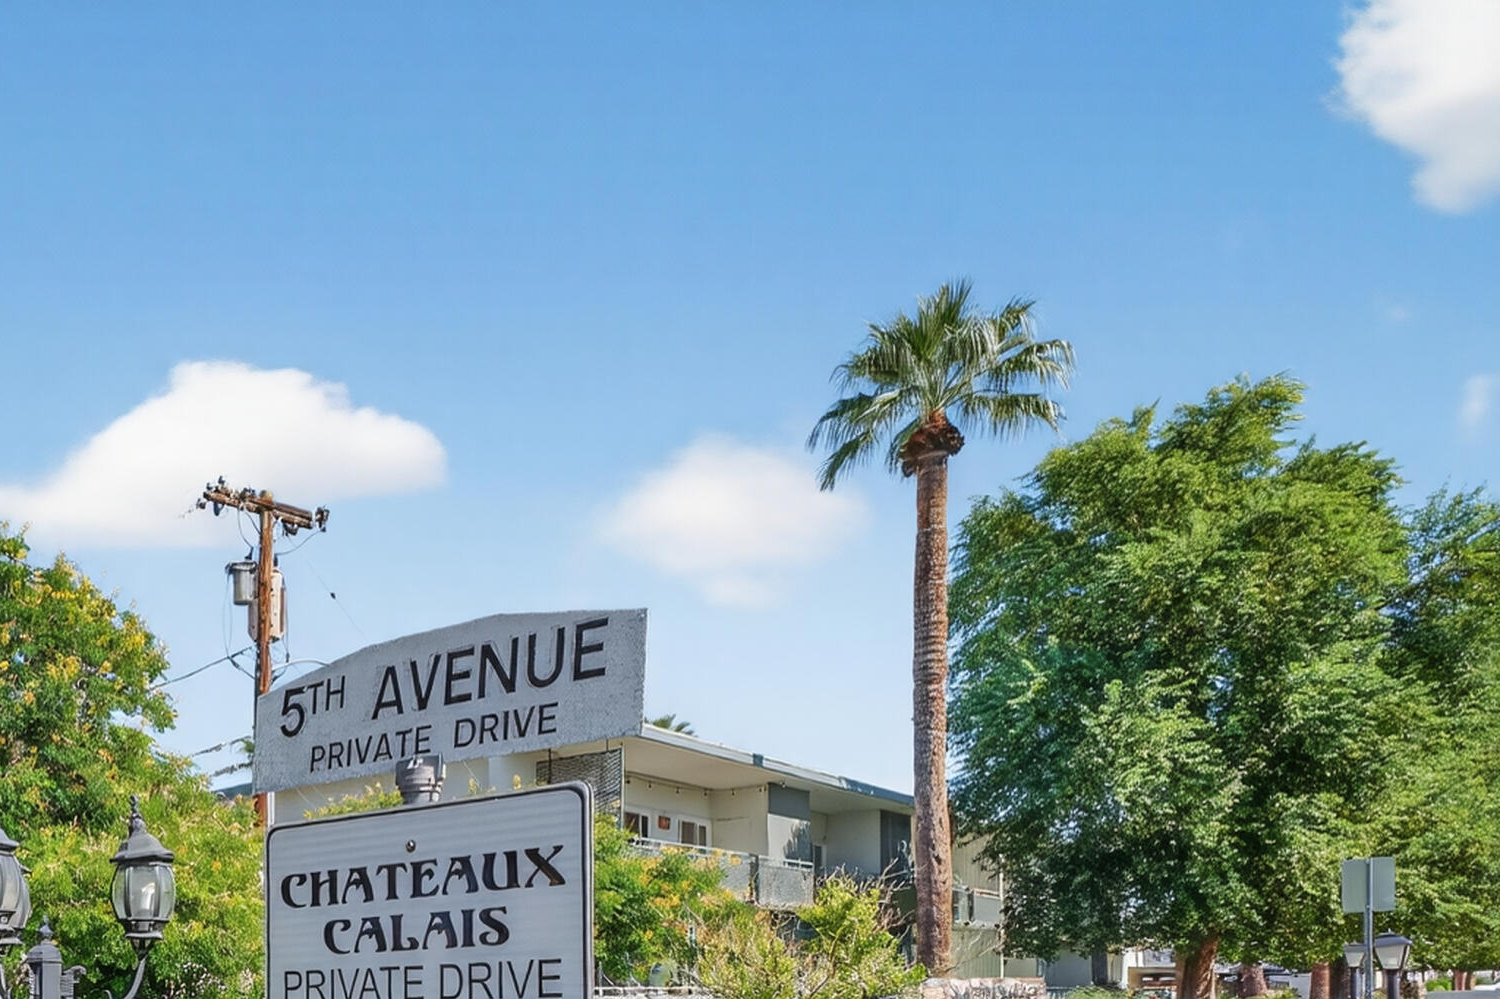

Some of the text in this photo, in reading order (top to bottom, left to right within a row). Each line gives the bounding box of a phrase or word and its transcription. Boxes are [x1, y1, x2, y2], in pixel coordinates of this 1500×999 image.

[279, 617, 610, 738] 5TH AVENUE
[309, 701, 559, 773] PRIVATE DRIVE
[280, 844, 567, 908] CHATEAUX
[323, 906, 510, 955] CALAIS
